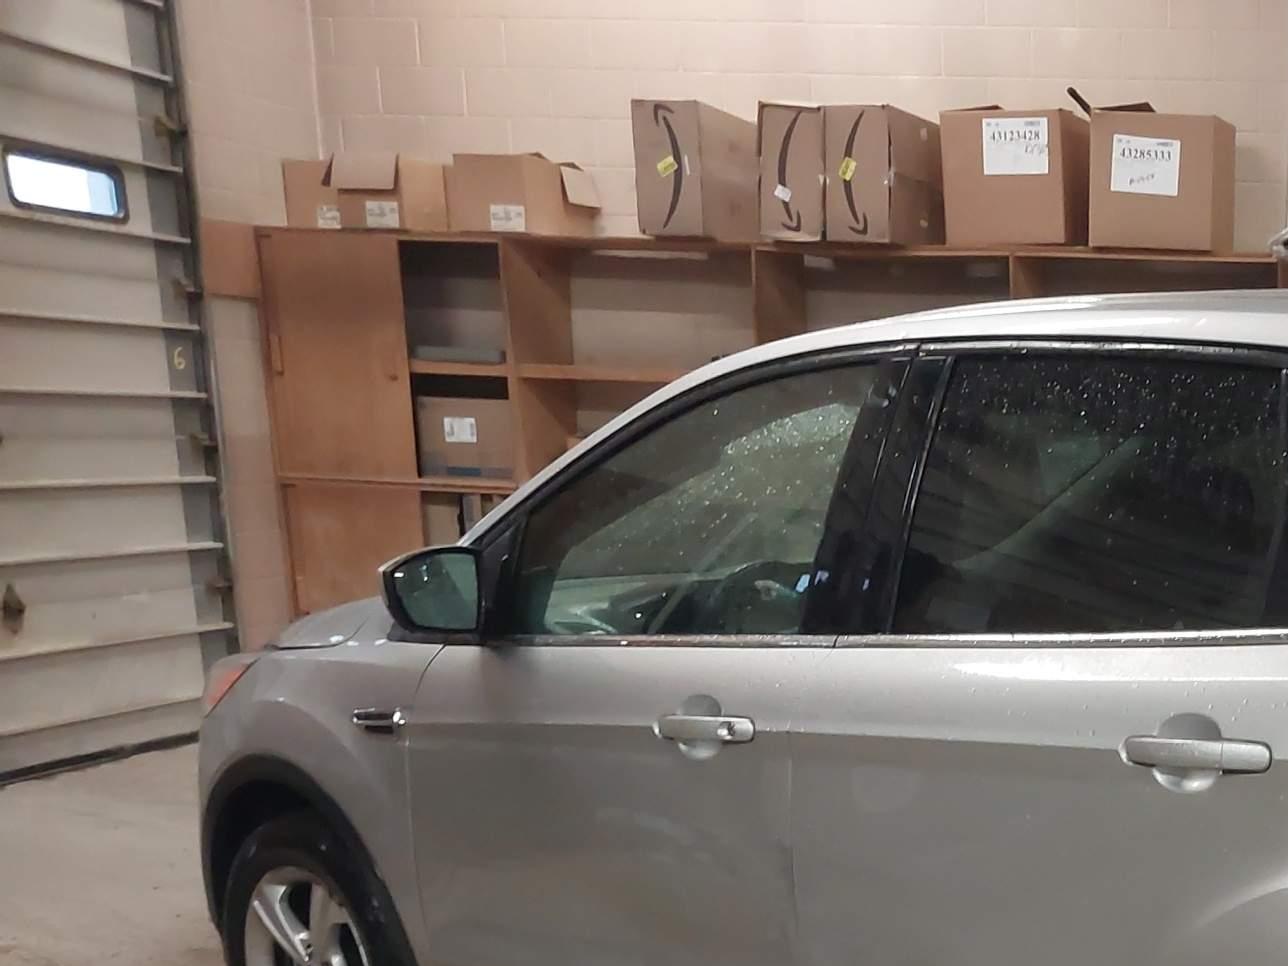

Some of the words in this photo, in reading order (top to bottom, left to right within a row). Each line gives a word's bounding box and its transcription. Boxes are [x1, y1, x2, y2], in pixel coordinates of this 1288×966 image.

[990, 129, 1040, 142] 43123428
[1119, 146, 1172, 161] 43285333
[174, 346, 186, 370] 6
